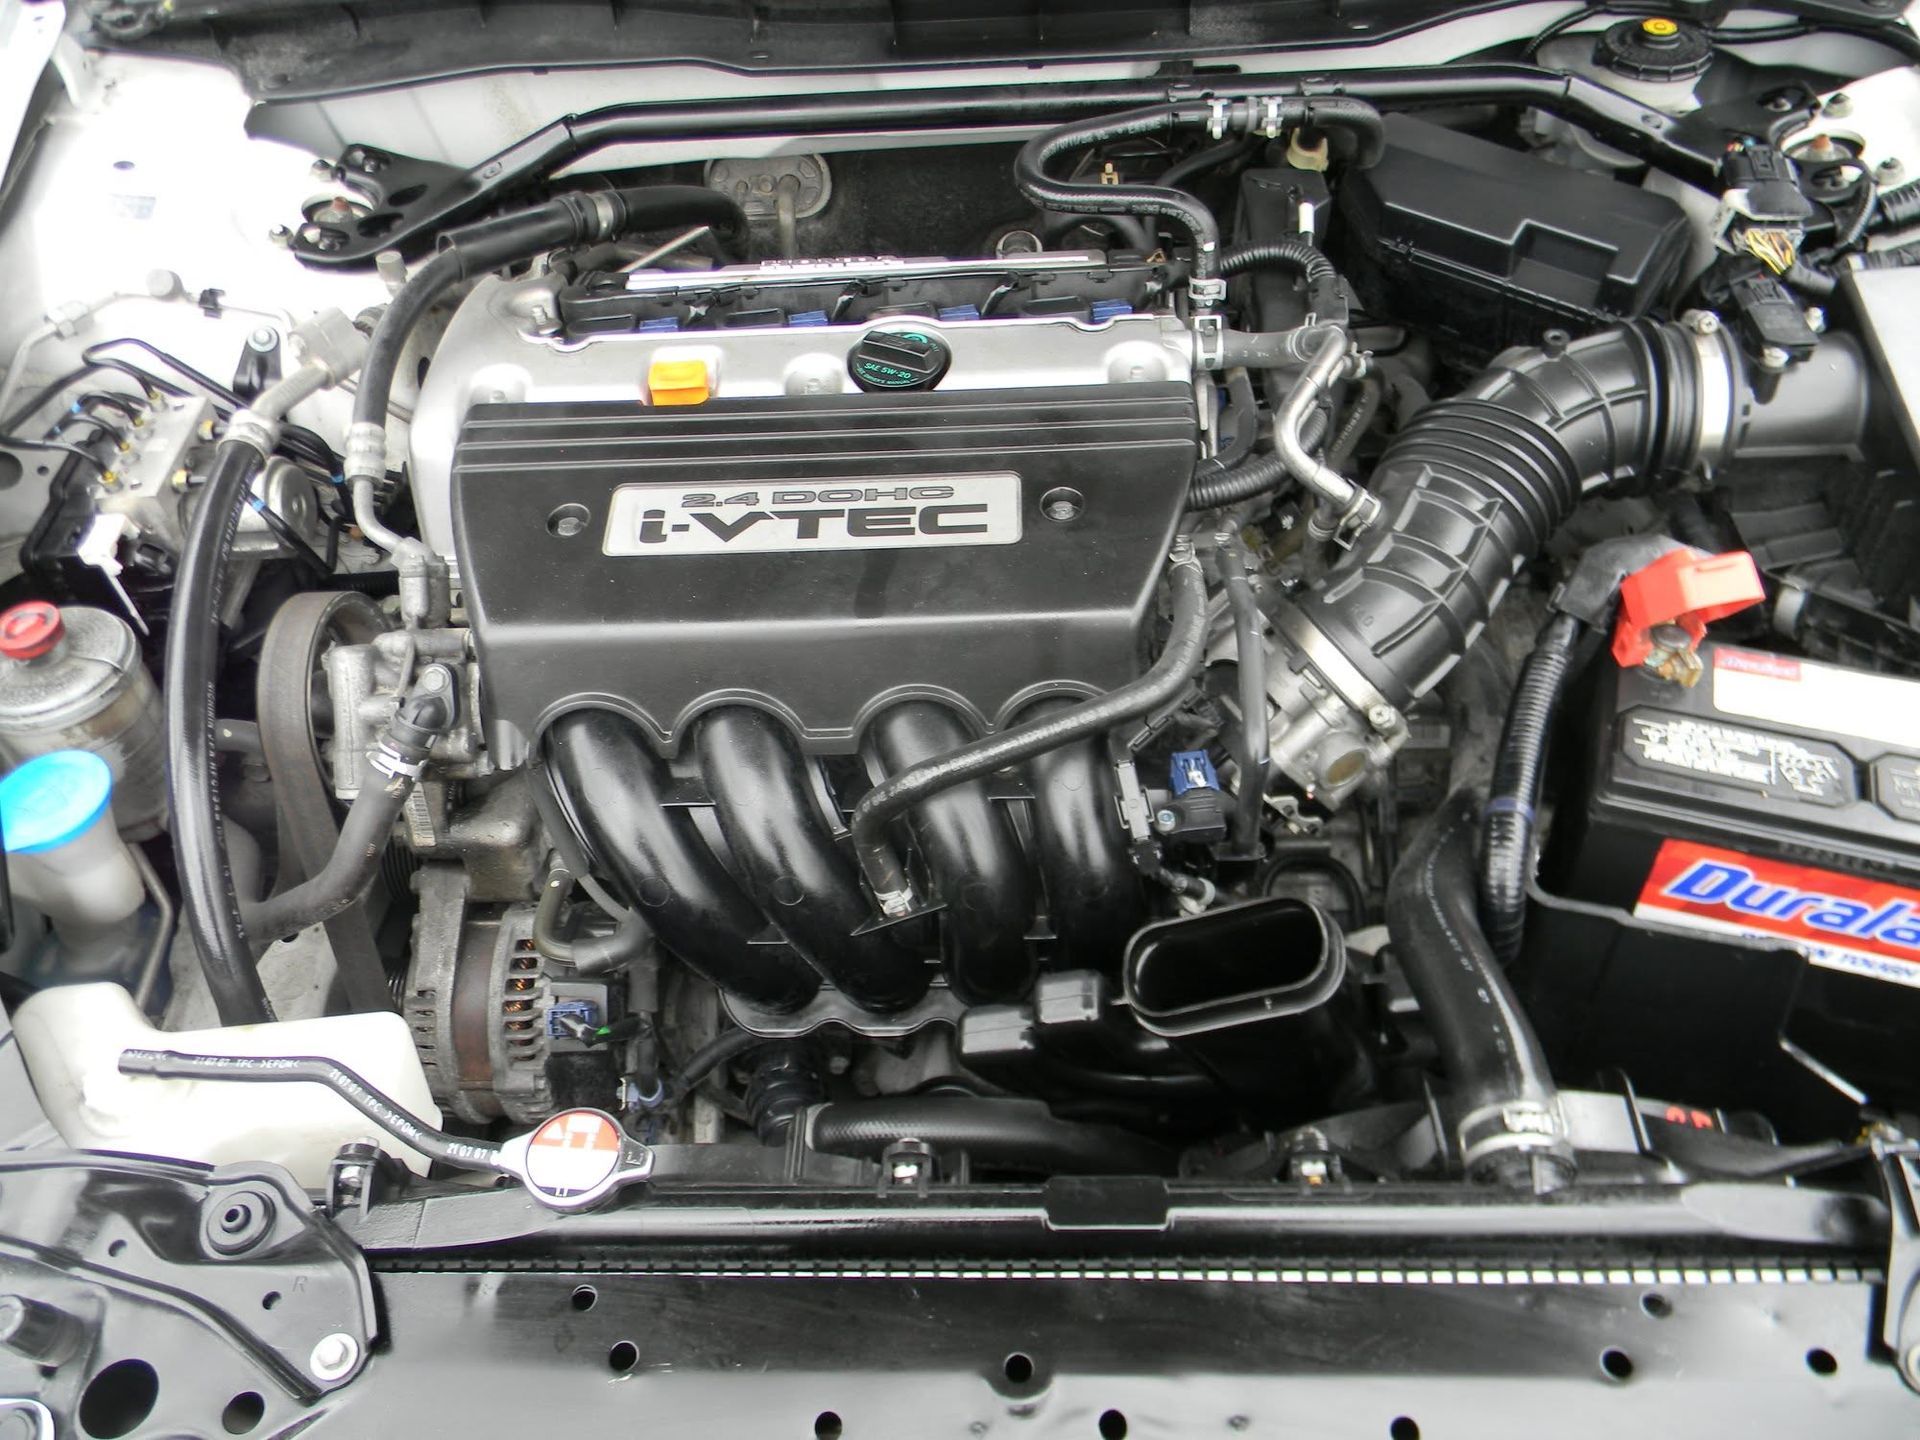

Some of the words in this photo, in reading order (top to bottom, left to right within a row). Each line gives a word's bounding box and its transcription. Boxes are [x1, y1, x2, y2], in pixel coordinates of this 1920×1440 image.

[864, 363, 880, 371] SAE
[682, 491, 760, 507] 2.4
[772, 486, 954, 504] DOHC
[639, 503, 988, 544] i-VTEC
